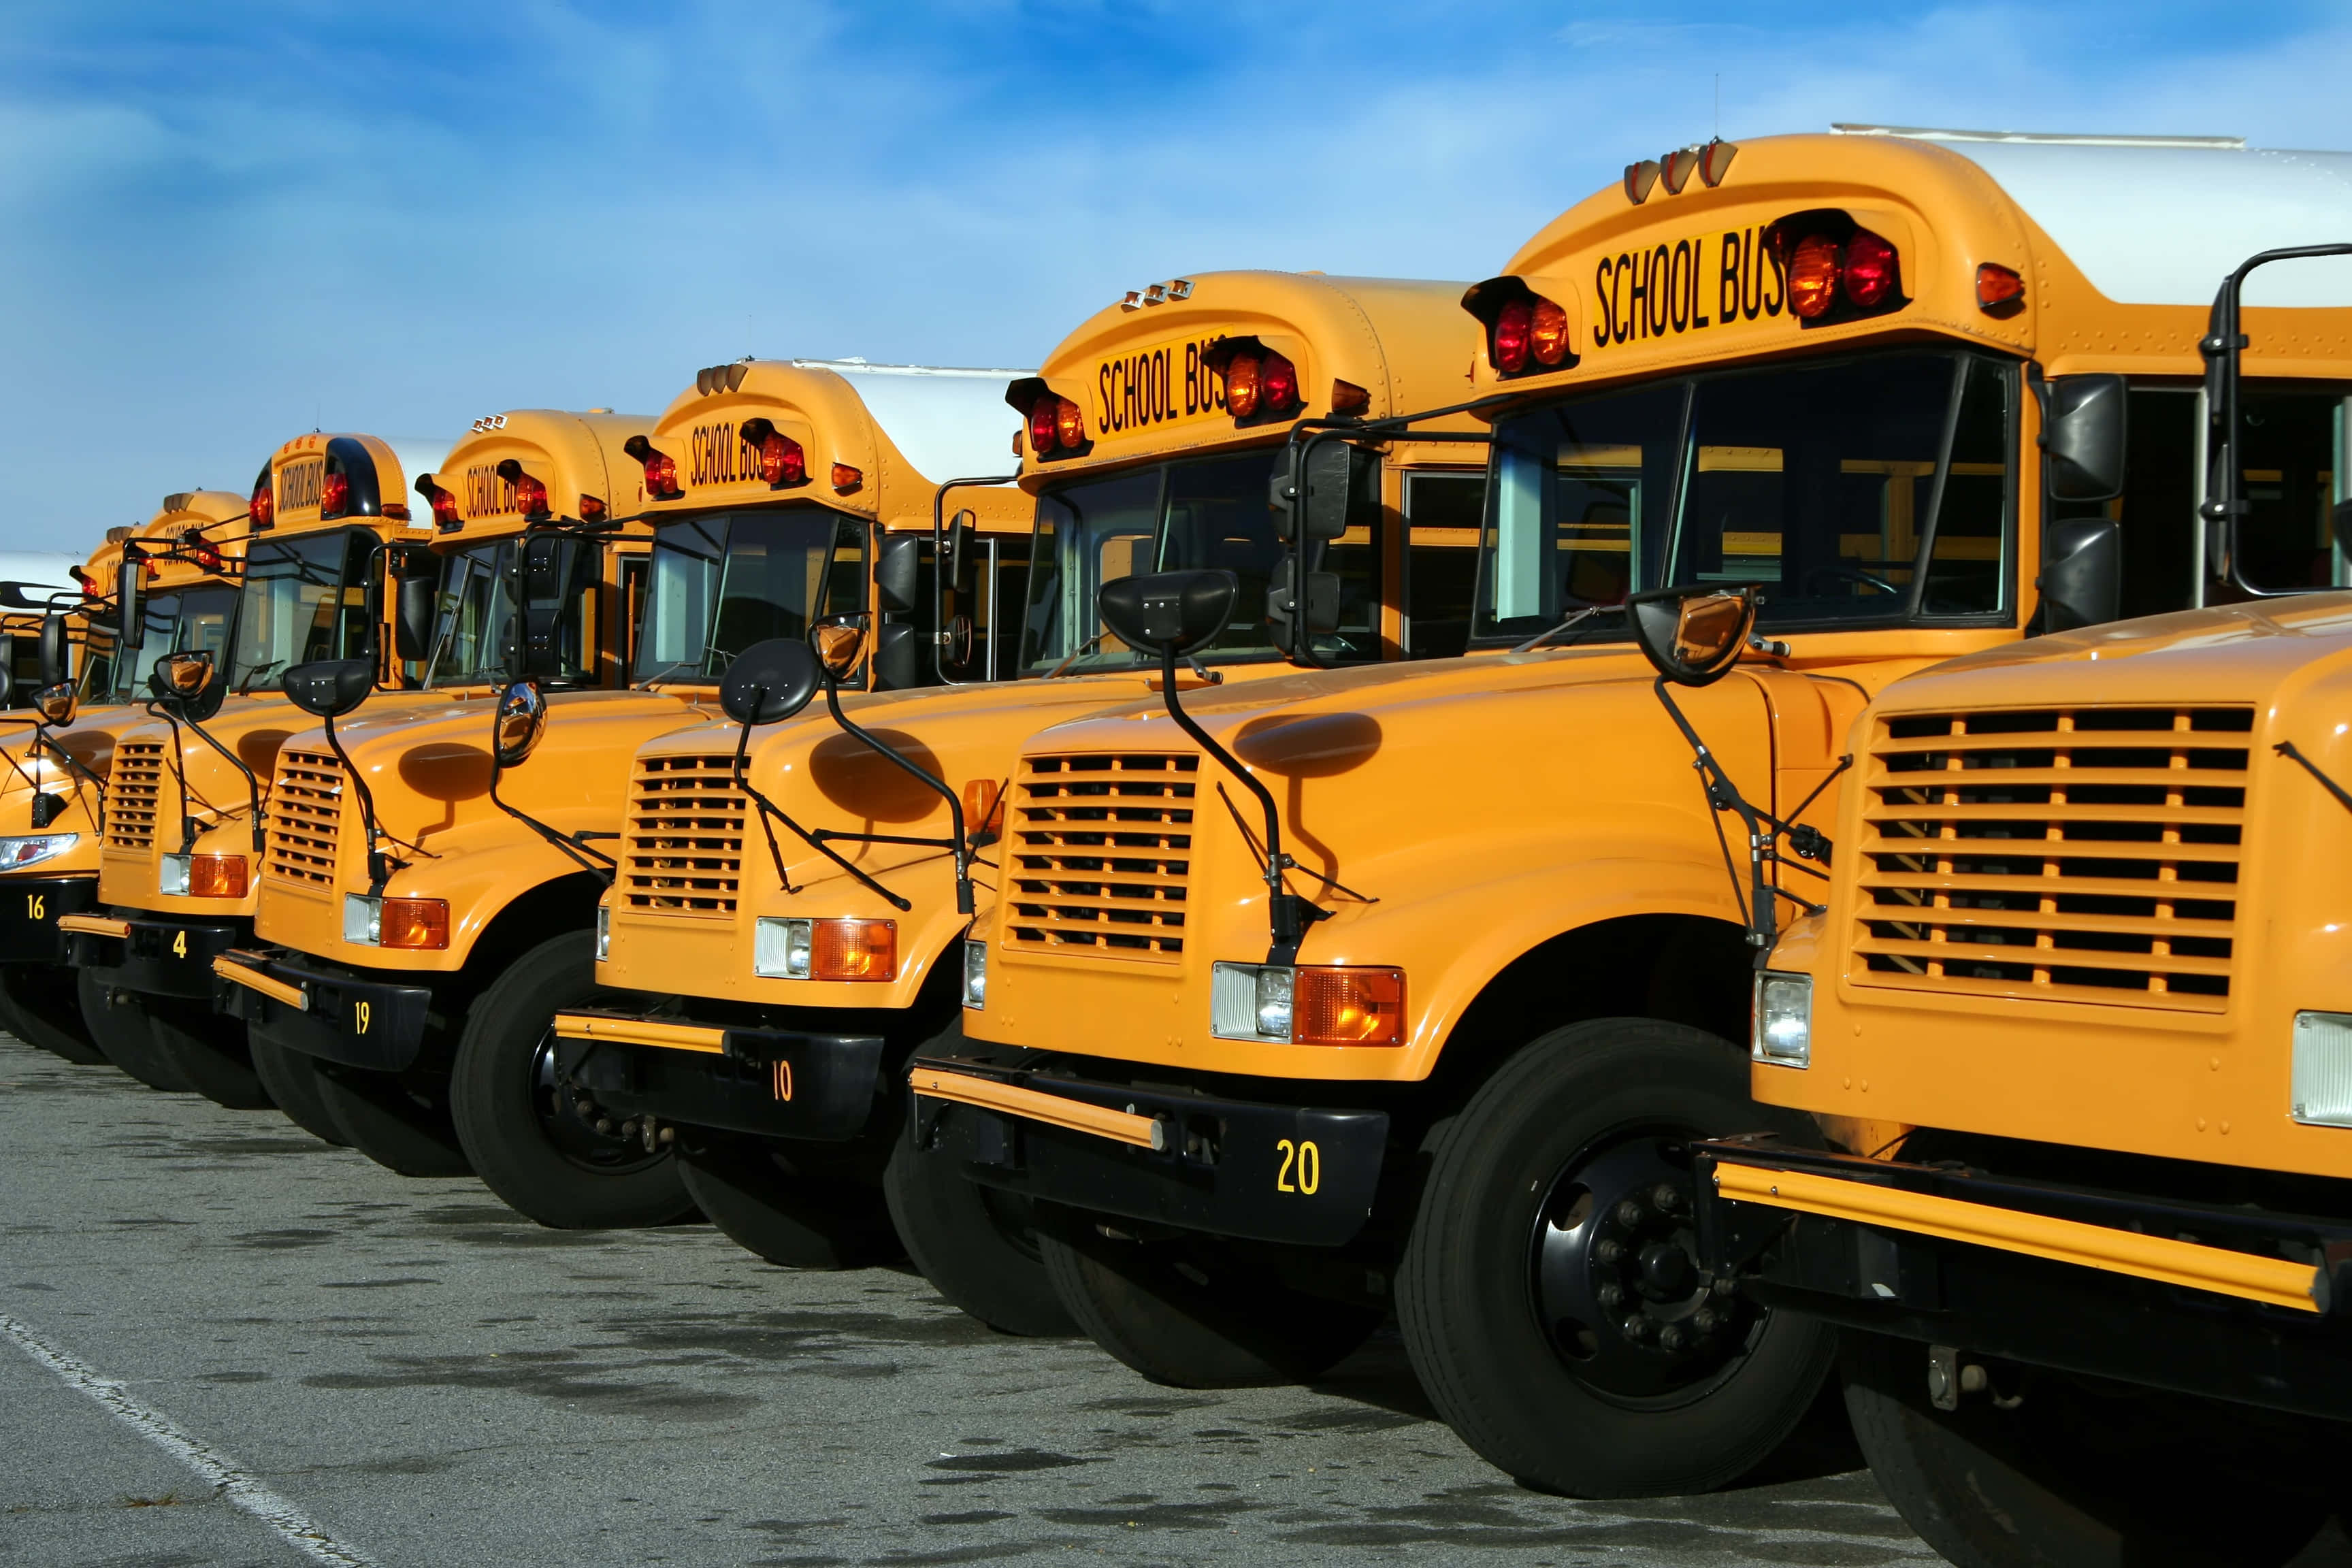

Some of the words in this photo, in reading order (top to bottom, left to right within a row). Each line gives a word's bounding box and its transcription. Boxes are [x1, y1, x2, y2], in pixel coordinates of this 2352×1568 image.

[1593, 238, 1710, 348] SCHOOL
[1720, 225, 1784, 325] BUS
[1098, 347, 1178, 435] SCHOOL
[691, 422, 736, 487] SCHOOL
[278, 463, 306, 512] SCHOOL
[306, 459, 323, 507] BUS
[466, 464, 501, 519] SCHOOL
[504, 478, 518, 514] BU
[27, 894, 44, 919] 16
[173, 930, 186, 959] 4
[355, 1002, 370, 1034] 19
[772, 1060, 792, 1102] 10
[1277, 1139, 1319, 1195] 20
